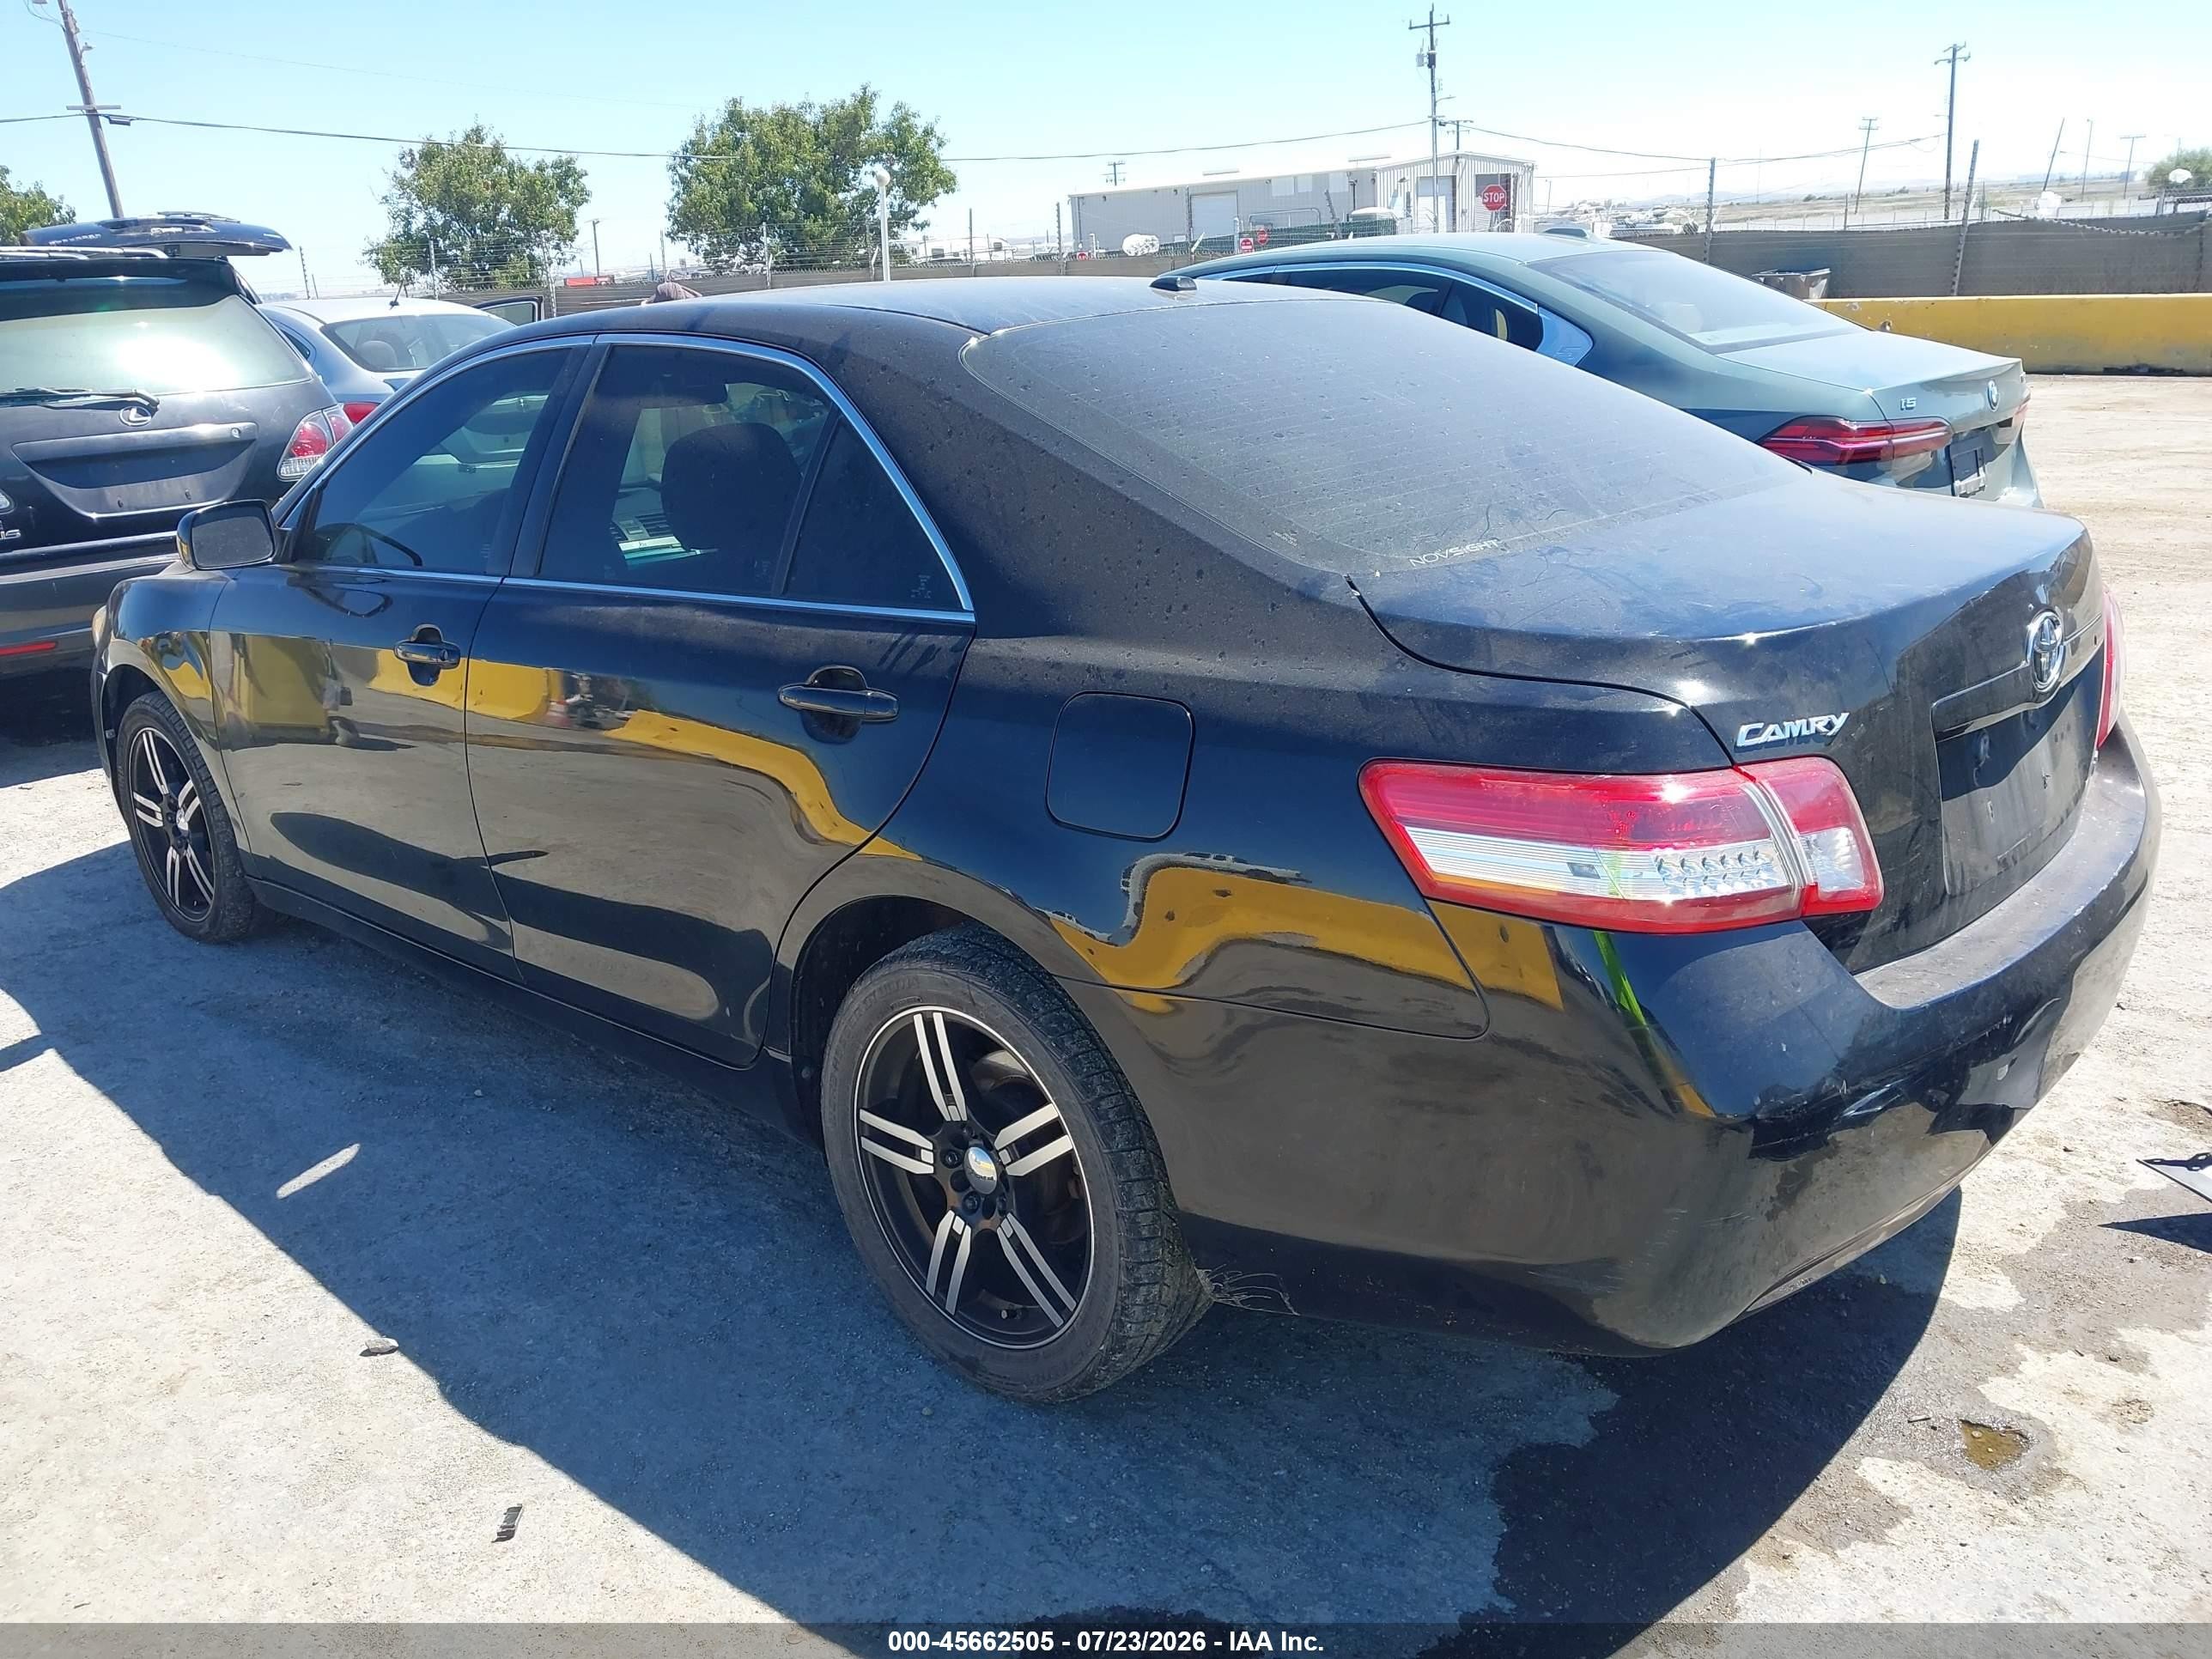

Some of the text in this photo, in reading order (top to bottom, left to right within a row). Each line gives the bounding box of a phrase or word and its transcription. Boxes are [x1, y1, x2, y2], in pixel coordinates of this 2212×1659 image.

[1483, 191, 1505, 203] STOP
[1408, 538, 1499, 567] NOVSIGHT
[1736, 712, 1850, 747] CAMRY
